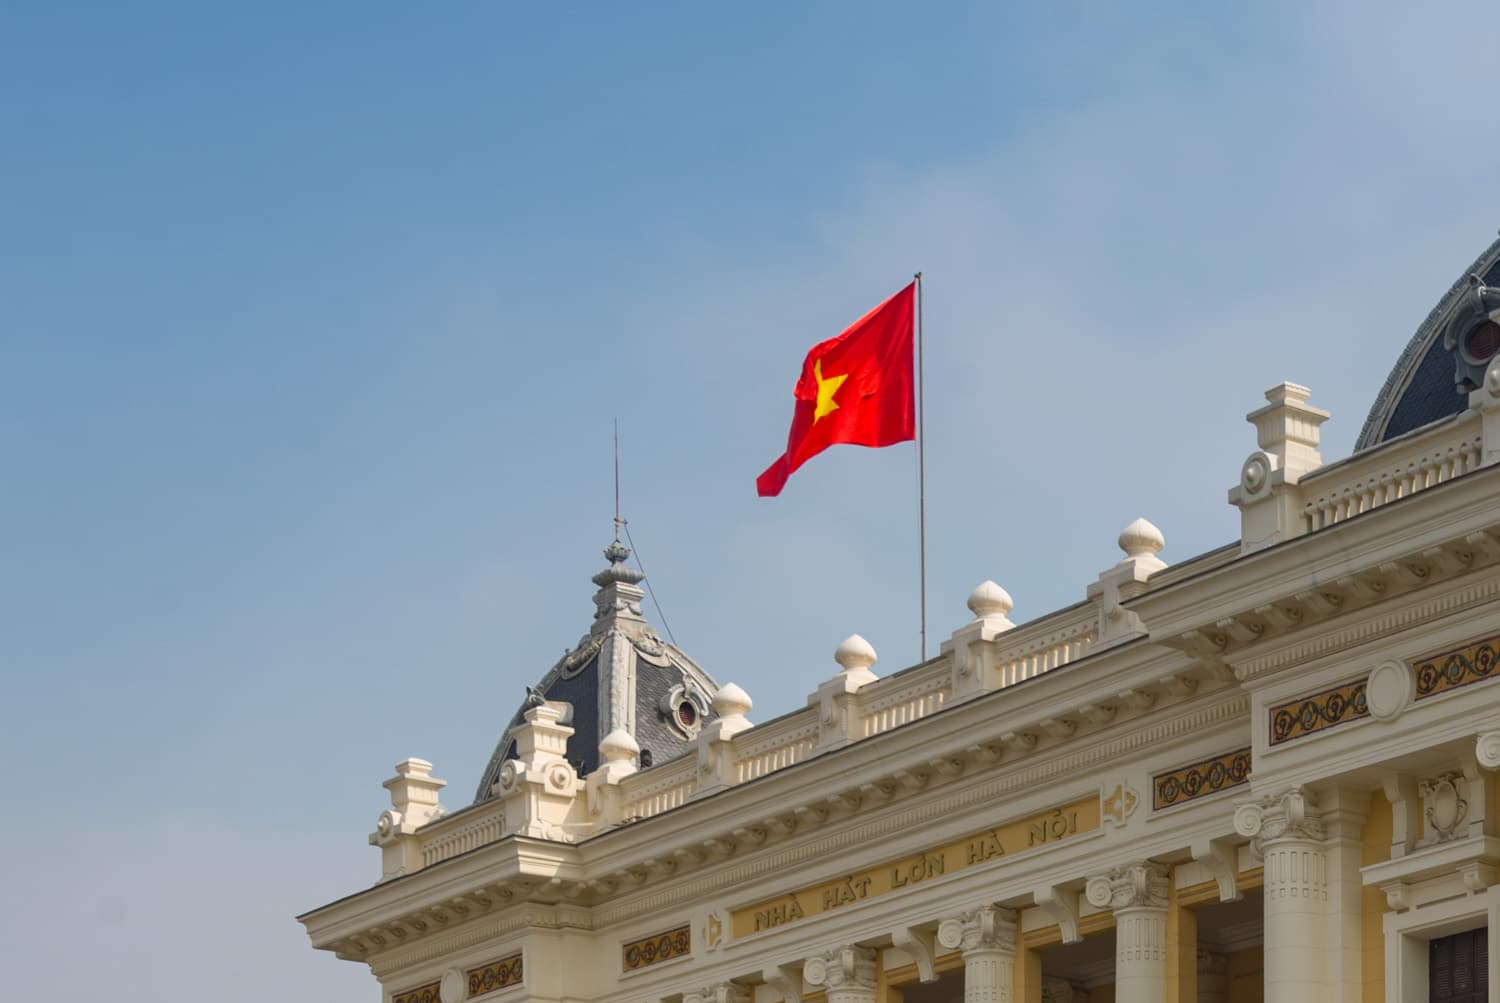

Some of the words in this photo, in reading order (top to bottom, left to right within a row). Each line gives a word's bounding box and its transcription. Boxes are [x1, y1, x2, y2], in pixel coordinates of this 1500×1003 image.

[754, 893, 804, 931] NHÀ
[823, 875, 871, 910] HÁT
[891, 853, 945, 889] LỚN
[967, 829, 1005, 865] HÀ
[1028, 809, 1078, 846] NỘI
